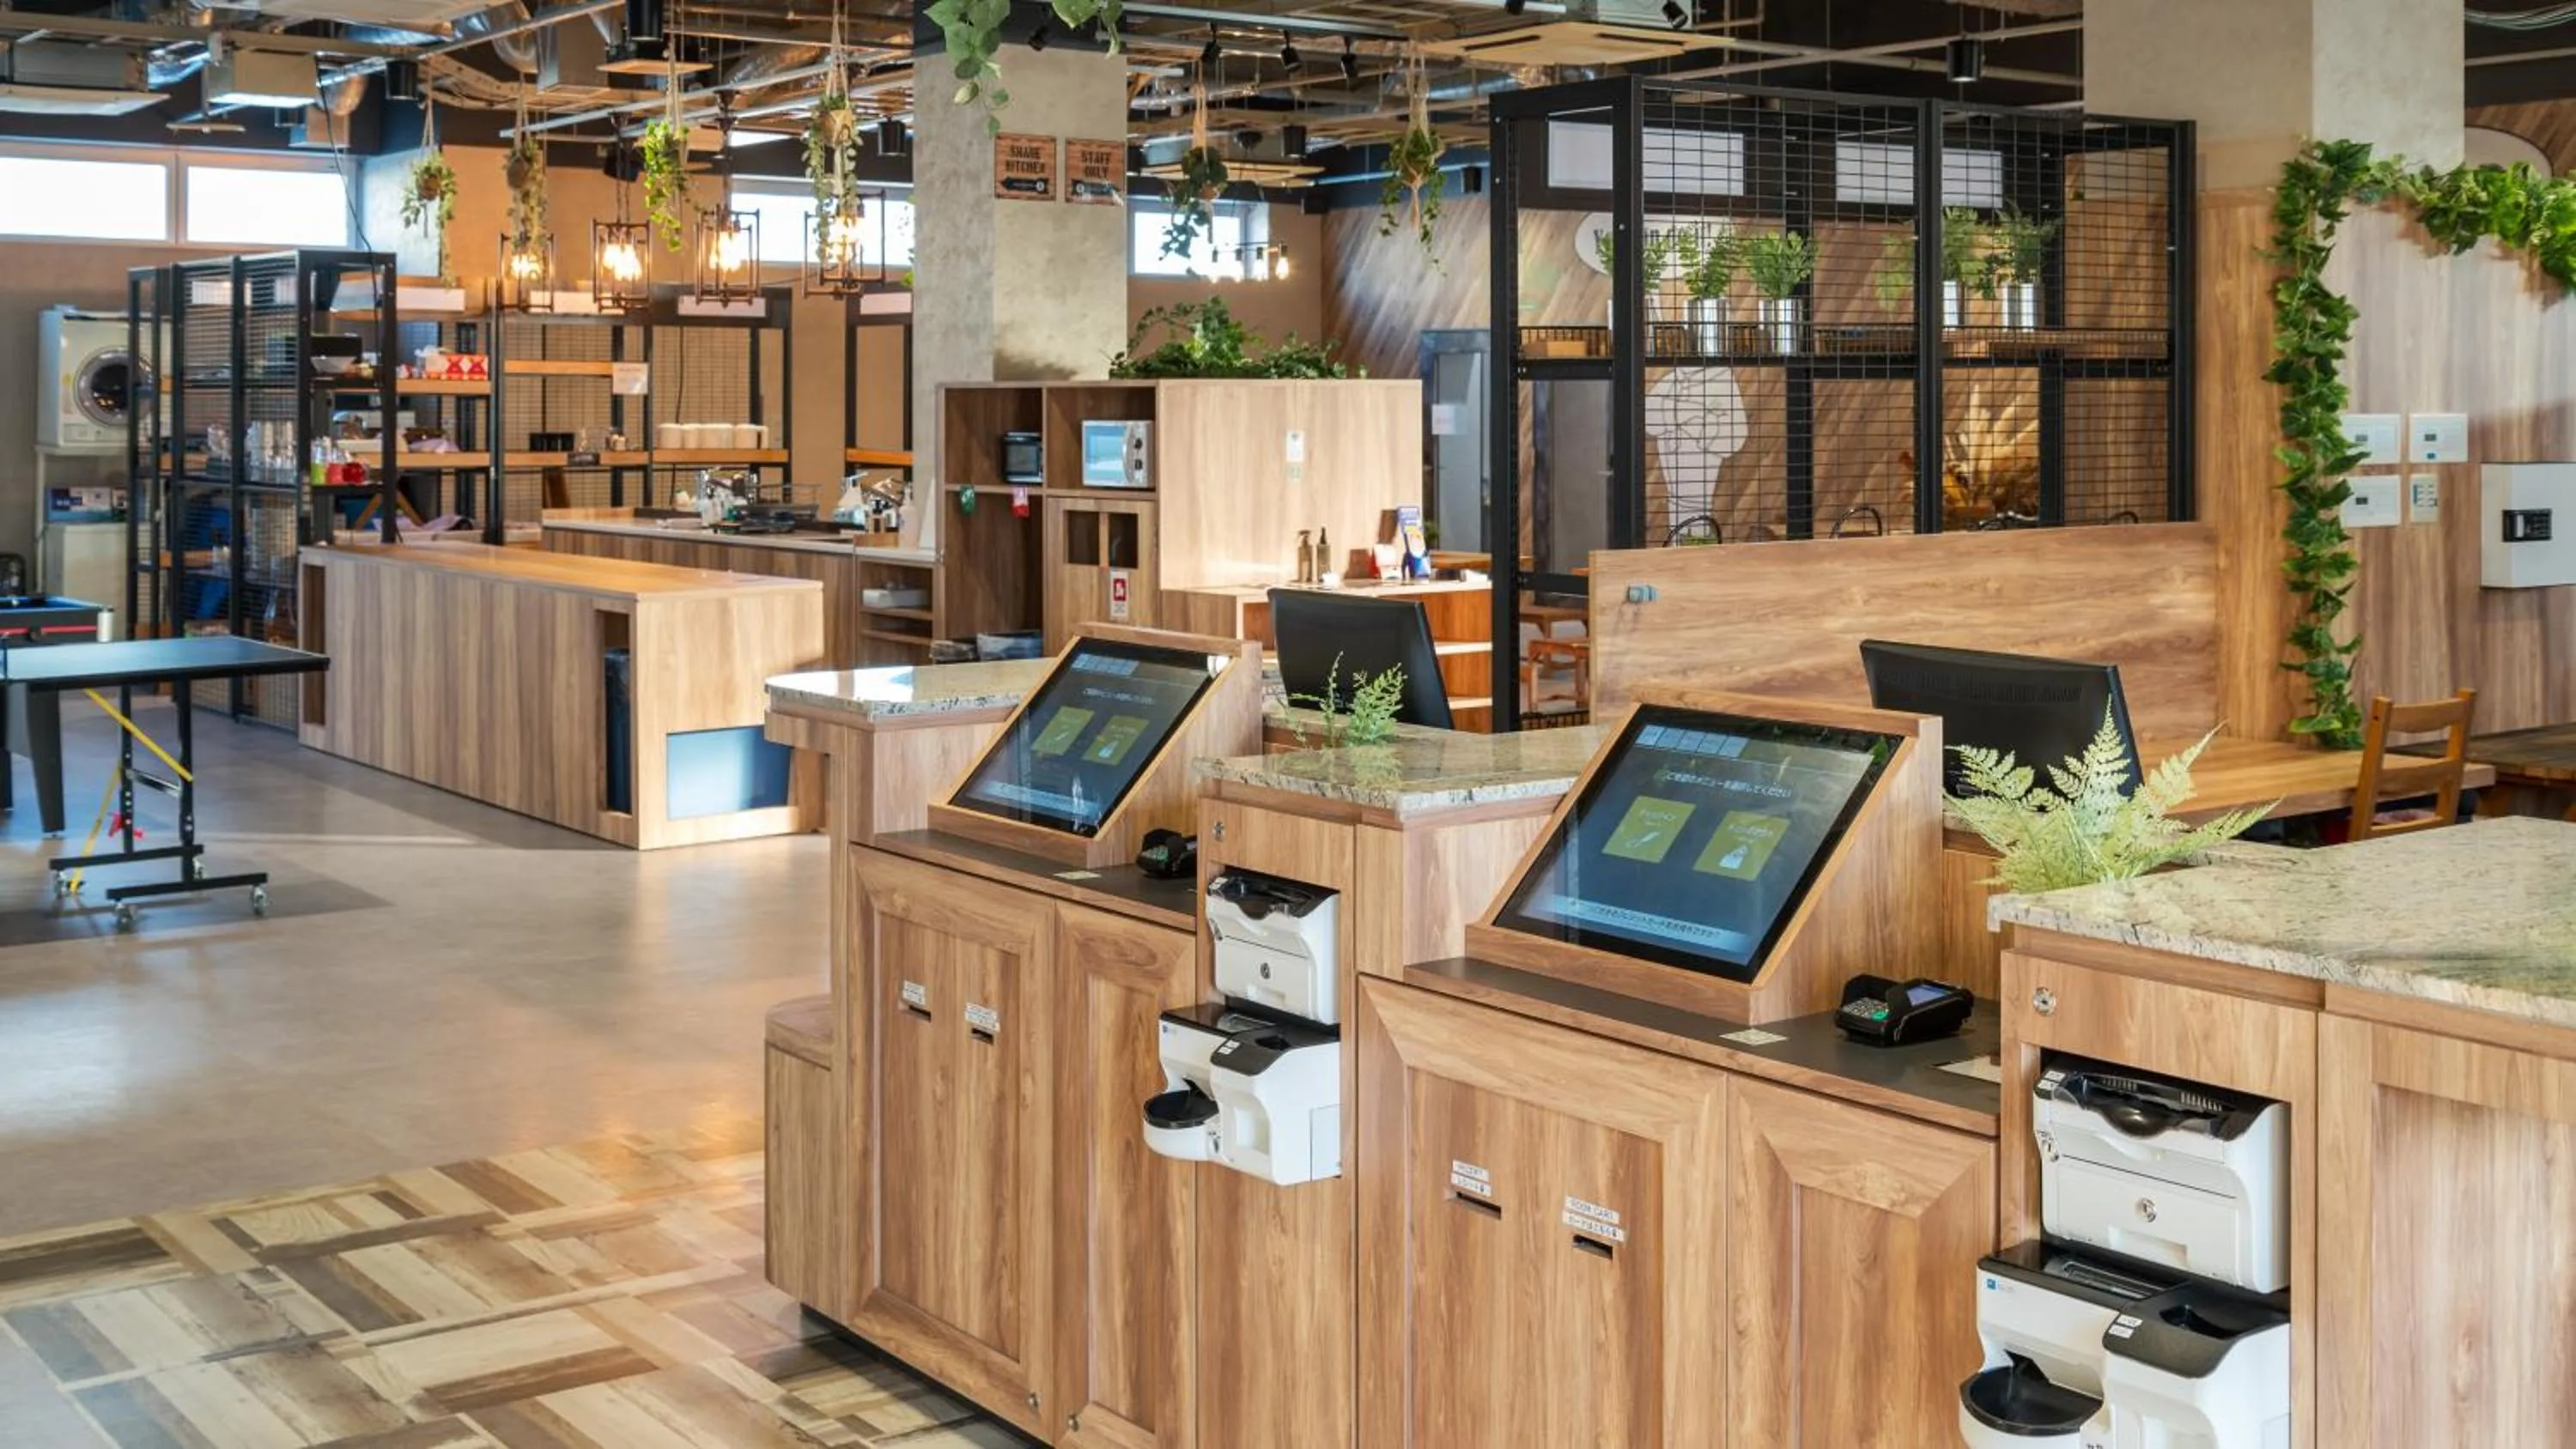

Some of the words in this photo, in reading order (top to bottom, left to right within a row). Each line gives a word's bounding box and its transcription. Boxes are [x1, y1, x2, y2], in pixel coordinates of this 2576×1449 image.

[1010, 144, 1041, 160] SHARE
[1080, 150, 1111, 165] STAFF
[1084, 165, 1109, 179] ONLY
